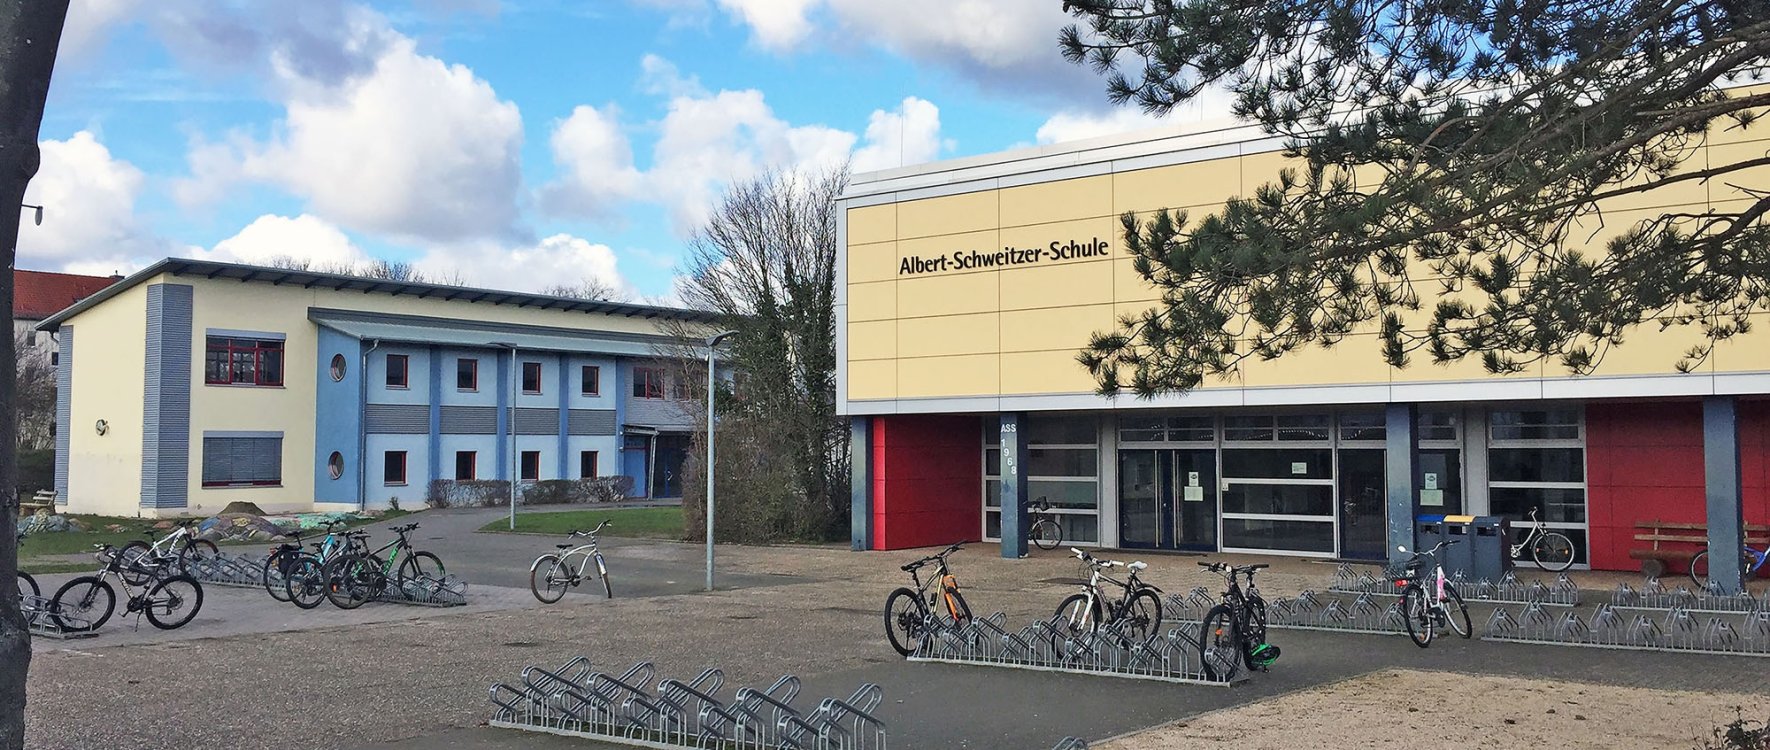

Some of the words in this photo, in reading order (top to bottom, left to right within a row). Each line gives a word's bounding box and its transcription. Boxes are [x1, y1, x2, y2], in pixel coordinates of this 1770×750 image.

[899, 237, 1109, 275] Albert-Schweitzer-Schule
[1000, 423, 1016, 433] ASS
[1001, 438, 1017, 475] 1968
